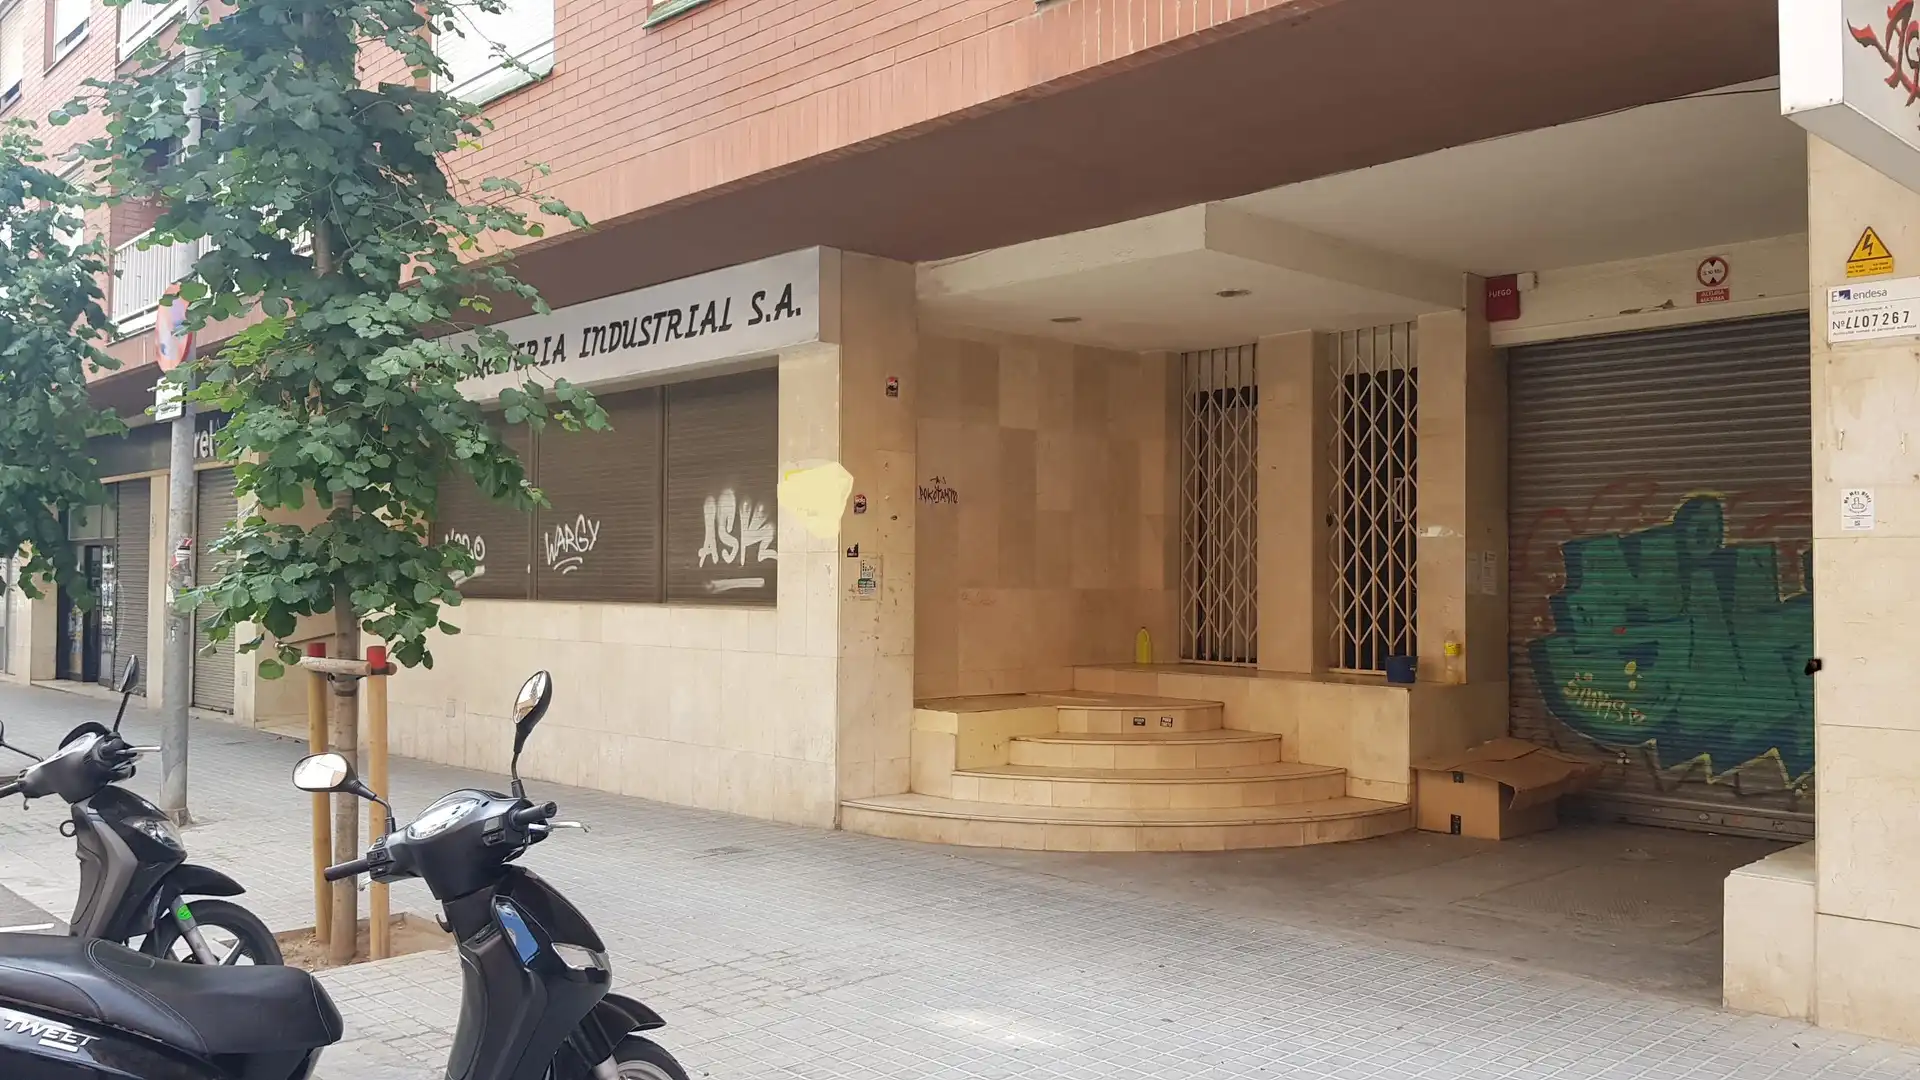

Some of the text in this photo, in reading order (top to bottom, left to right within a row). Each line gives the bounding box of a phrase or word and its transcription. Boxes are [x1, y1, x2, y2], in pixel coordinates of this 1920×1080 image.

[1853, 289, 1888, 300] endesa
[579, 297, 733, 358] INDUSTRIAL
[748, 283, 802, 326] S.A.
[545, 514, 600, 565] WARGY
[4, 1019, 101, 1046] TWEET
